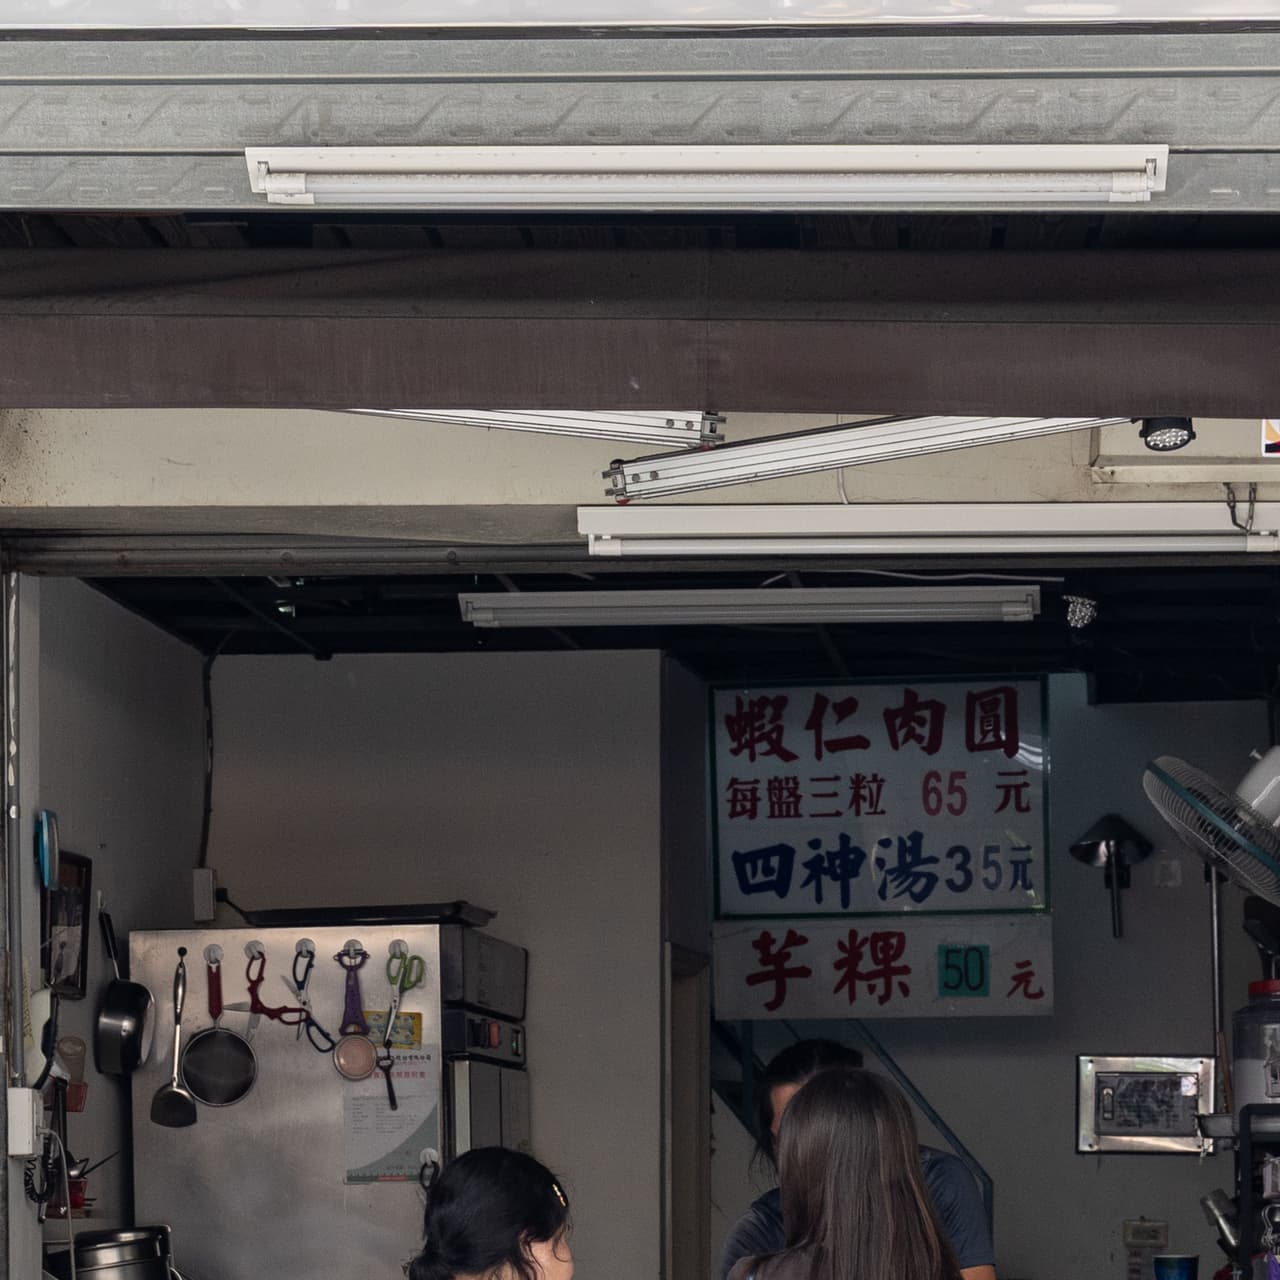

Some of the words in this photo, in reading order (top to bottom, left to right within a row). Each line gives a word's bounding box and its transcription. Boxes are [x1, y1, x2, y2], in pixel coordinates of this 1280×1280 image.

[725, 686, 1020, 763] 蝦仁肉圓
[726, 773, 886, 820] 每盤三粒
[922, 771, 967, 816] 65
[994, 770, 1032, 815] 元
[746, 928, 912, 1012] 芋粿
[943, 947, 986, 992] 50
[1007, 960, 1044, 1001] 元
